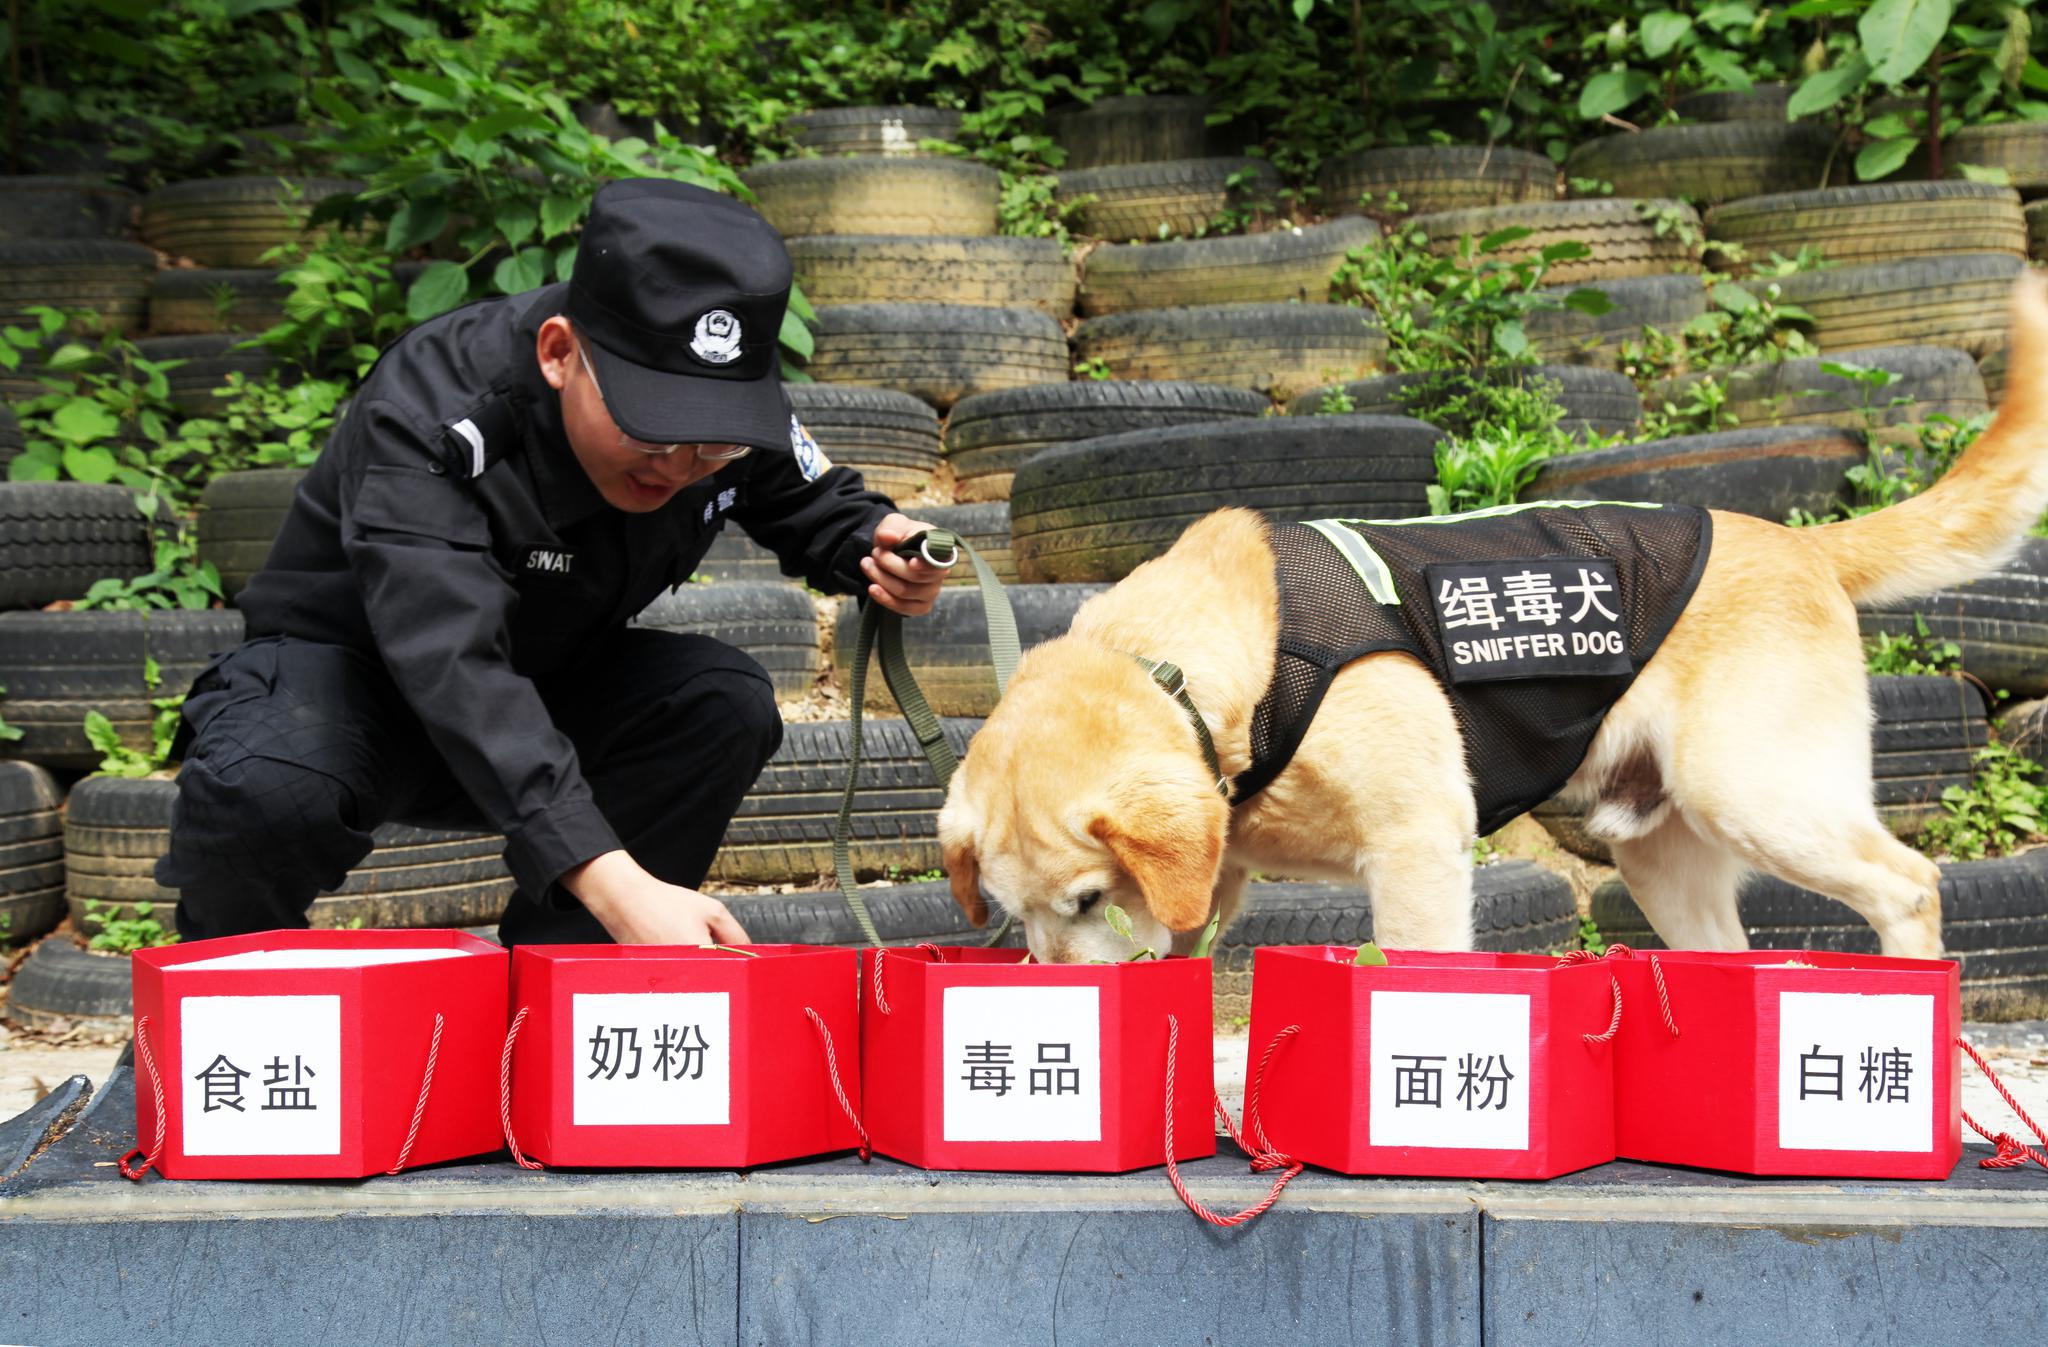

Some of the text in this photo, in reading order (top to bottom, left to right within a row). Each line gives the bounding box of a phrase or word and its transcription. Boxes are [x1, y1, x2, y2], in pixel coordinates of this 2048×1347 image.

[526, 550, 574, 573] SWAT
[1438, 568, 1619, 631] 缉毒犬
[1452, 630, 1624, 665] SNIFFER DOG
[587, 1024, 710, 1082] 奶粉
[961, 1040, 1081, 1098] 毒品
[1391, 1053, 1515, 1111] 面粉
[1799, 1044, 1914, 1104] 白糖
[194, 1053, 318, 1113] 食盐
